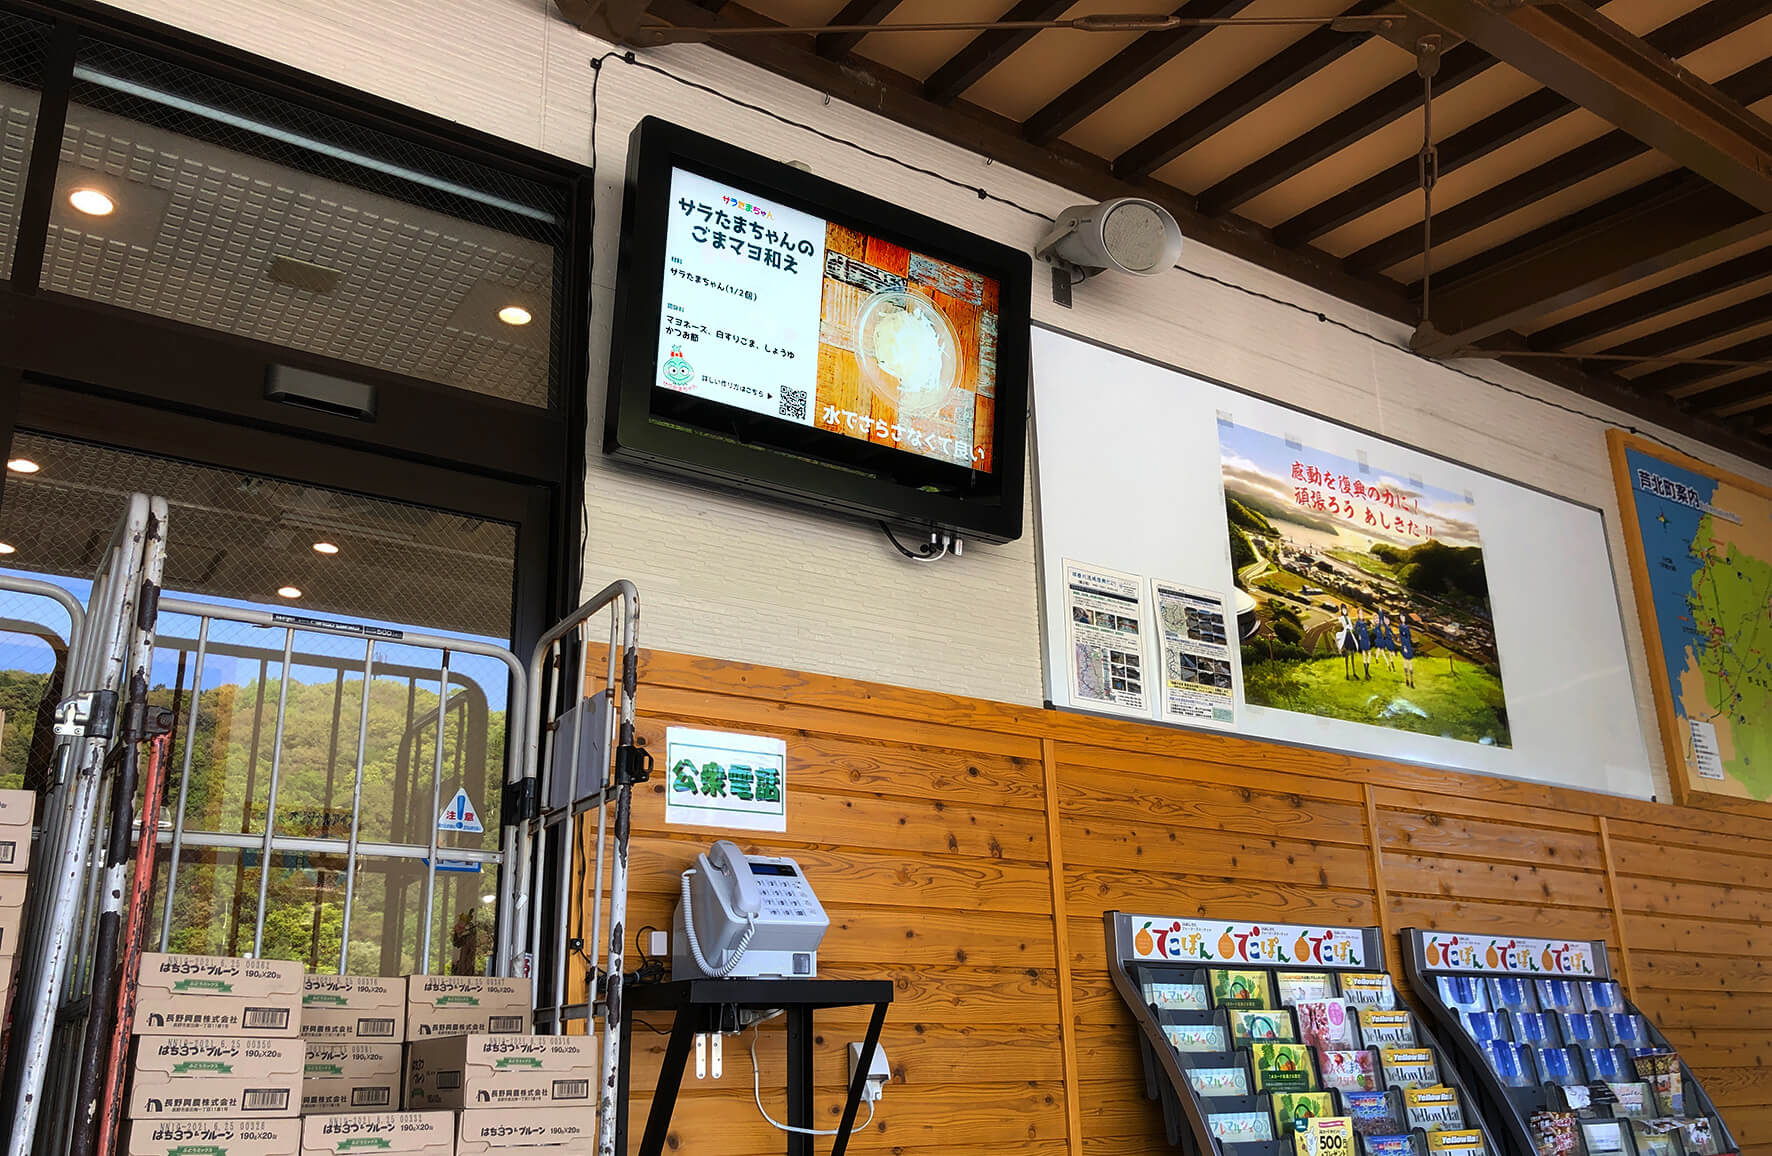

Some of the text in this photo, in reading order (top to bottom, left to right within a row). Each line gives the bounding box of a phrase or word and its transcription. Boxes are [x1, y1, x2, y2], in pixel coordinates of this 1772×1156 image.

[722, 195, 774, 221] サラたまちゃん
[678, 197, 815, 257] サラたまちゃんの
[692, 226, 799, 275] ごまマヨ和え
[822, 404, 985, 463] 水でさらさなくて良い
[1291, 460, 1418, 515] 感動を復興の力に!
[1294, 486, 1355, 519] 頑張ろう
[672, 758, 781, 802] 公衆電話
[1152, 921, 1214, 961] でこぽん
[1234, 925, 1291, 963] でこぽん
[1309, 930, 1362, 966] でこぽん
[1438, 936, 1483, 969] でこぽん
[1497, 939, 1540, 971] でこぽん
[1551, 943, 1592, 974] でこぽん
[1384, 1067, 1418, 1081] Yellow
[1410, 1107, 1443, 1122] Yellow
[1319, 1135, 1342, 1150] 500
